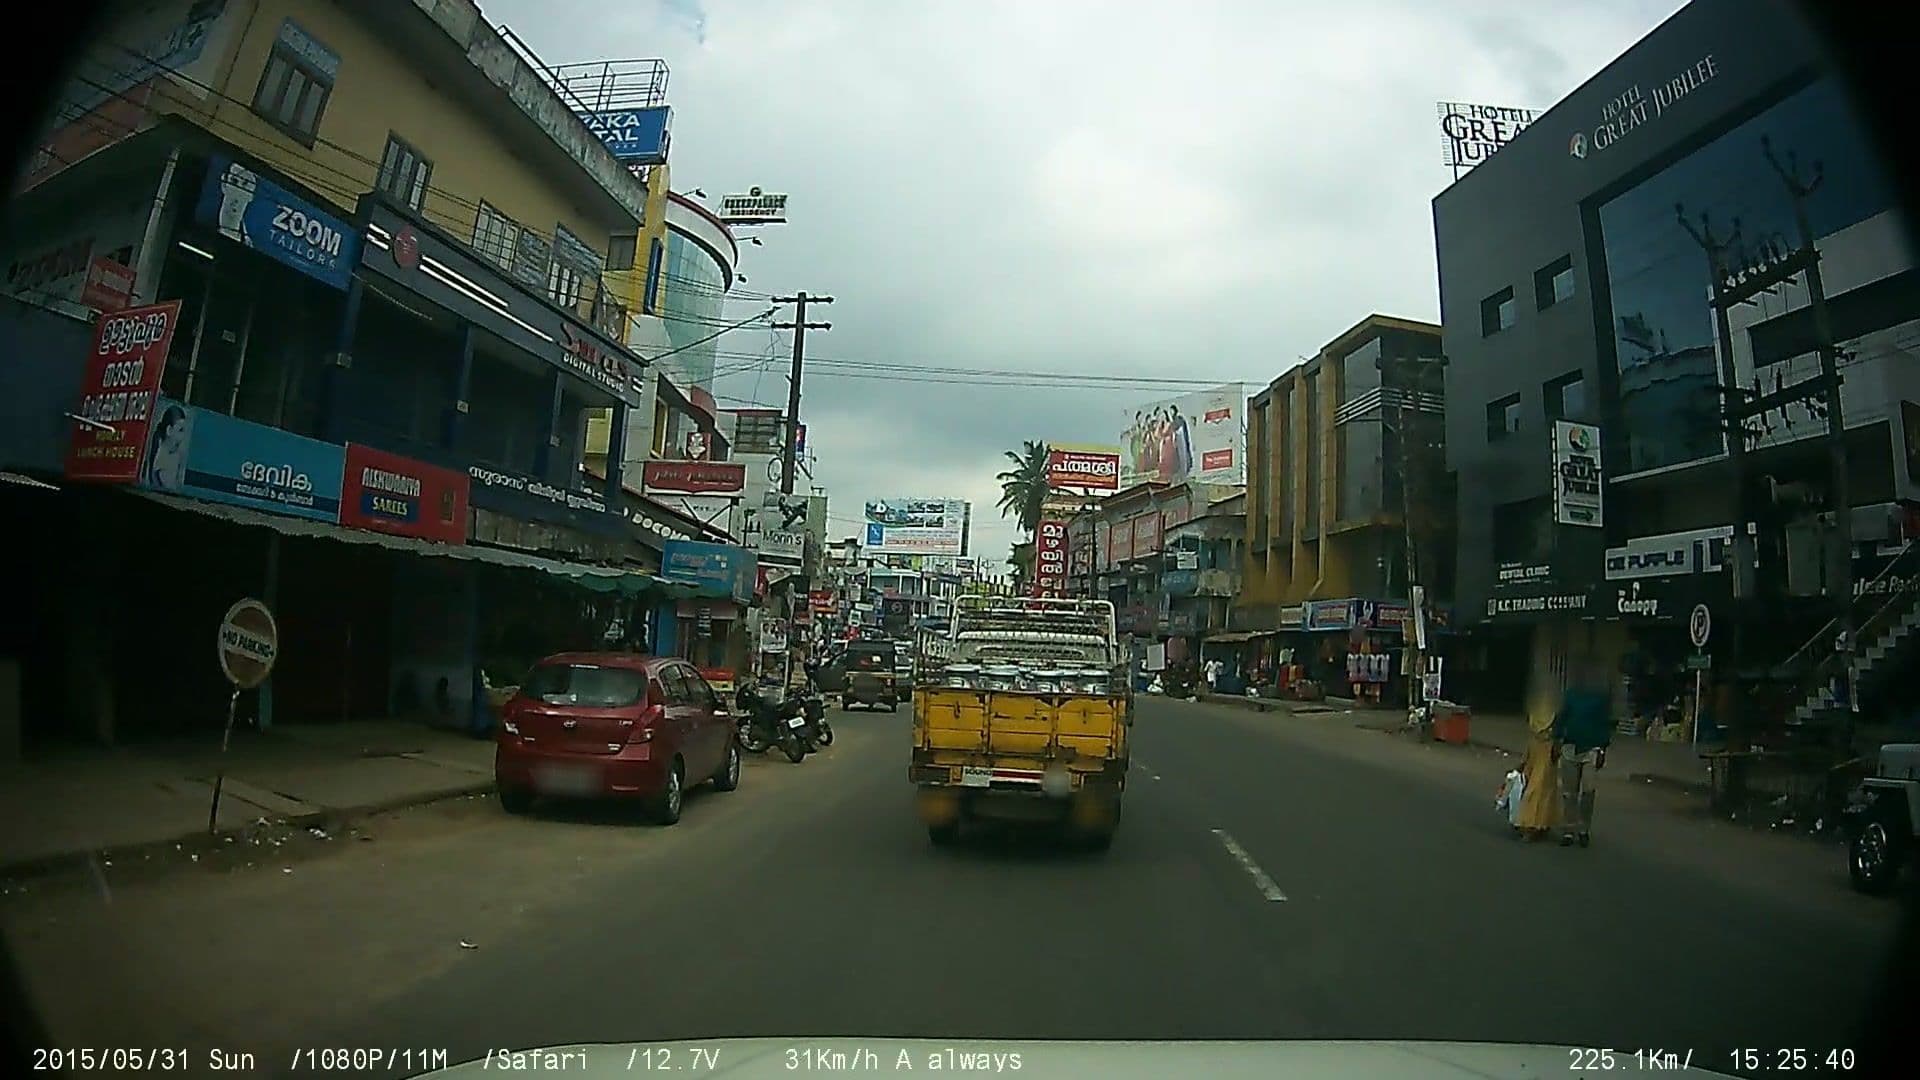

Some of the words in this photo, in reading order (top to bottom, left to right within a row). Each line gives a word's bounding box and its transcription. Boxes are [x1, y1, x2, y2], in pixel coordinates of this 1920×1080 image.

[1593, 100, 1651, 151] GREAT
[1651, 55, 1718, 117] JUBILEE
[1602, 84, 1642, 122] HOTEL
[271, 204, 342, 256] ZOOM
[268, 229, 337, 271] TAILORS
[563, 352, 596, 377] DIGITAL
[105, 445, 136, 459] HOUSE
[241, 460, 313, 492] ദേവിക
[371, 496, 408, 516] SAREES
[1512, 597, 1545, 611] TRADING
[1617, 596, 1658, 616] Canopy
